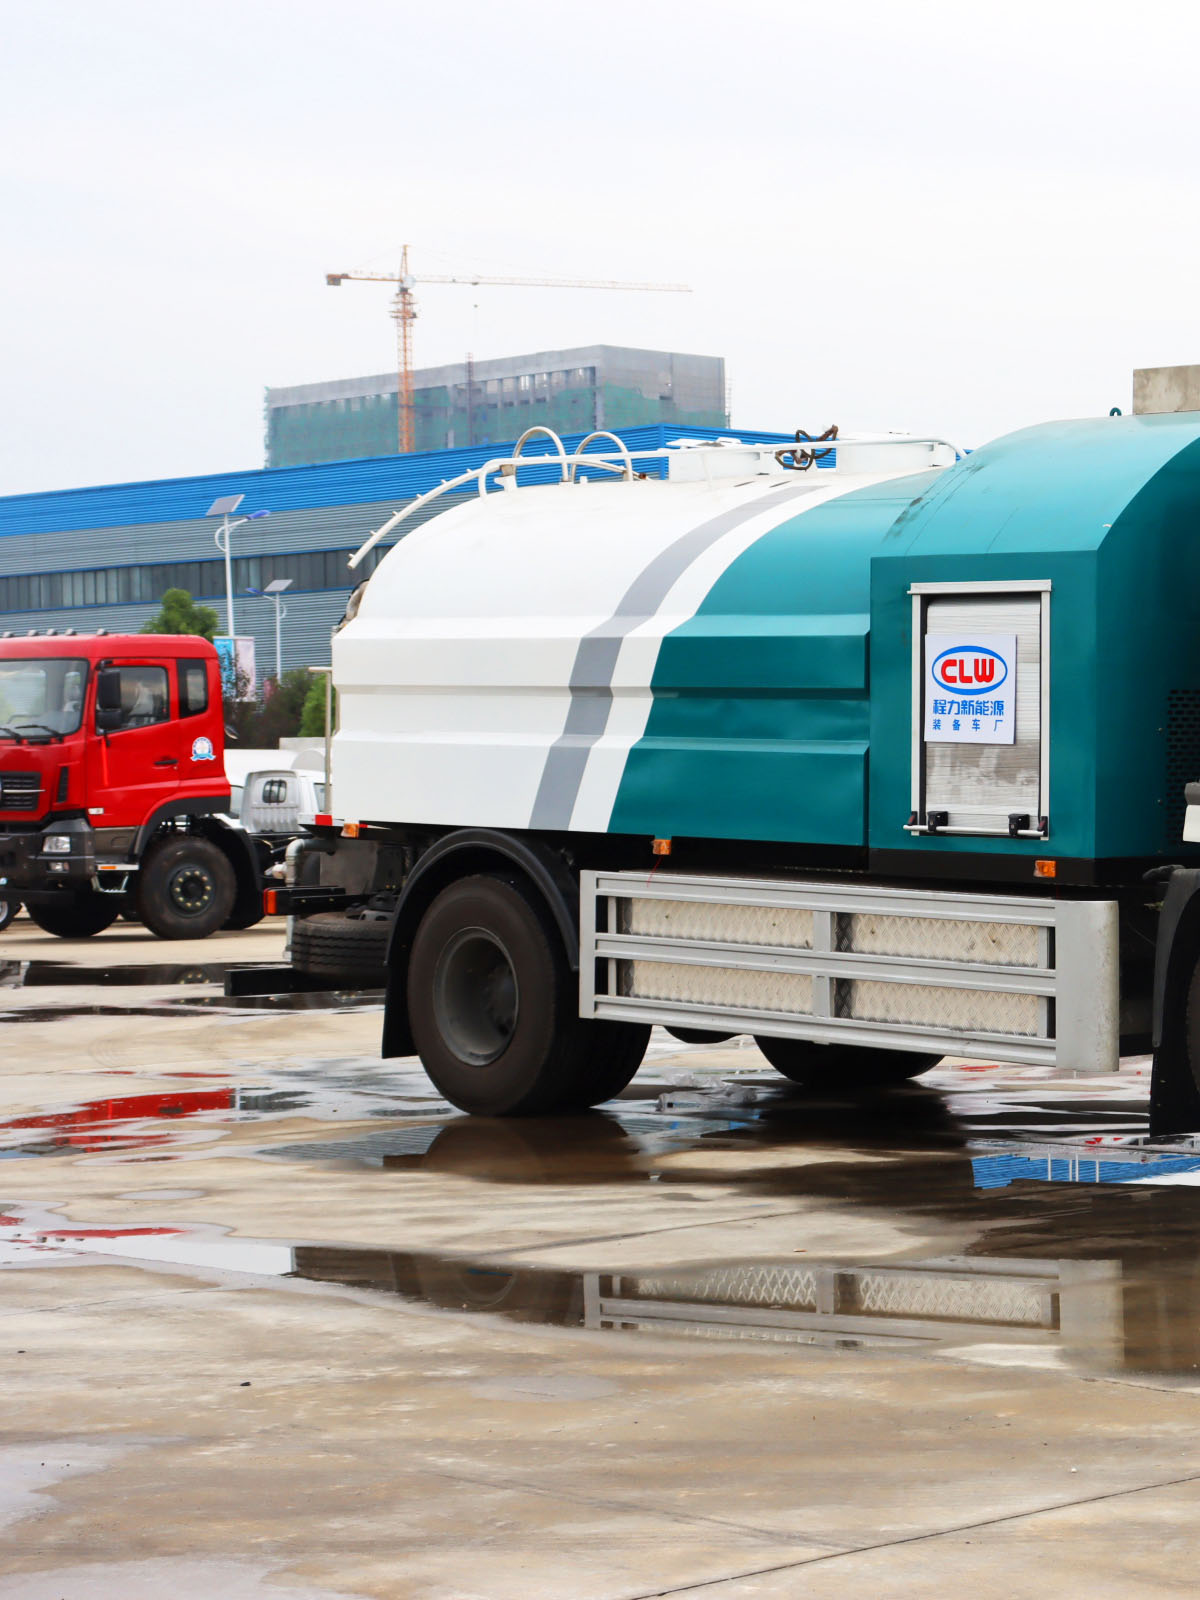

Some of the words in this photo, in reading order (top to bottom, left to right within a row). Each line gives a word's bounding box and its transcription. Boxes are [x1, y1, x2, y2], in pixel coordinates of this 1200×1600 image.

[940, 658, 995, 684] CLW
[932, 699, 1005, 717] 程力新能源
[932, 718, 1004, 732] 装备车厂
